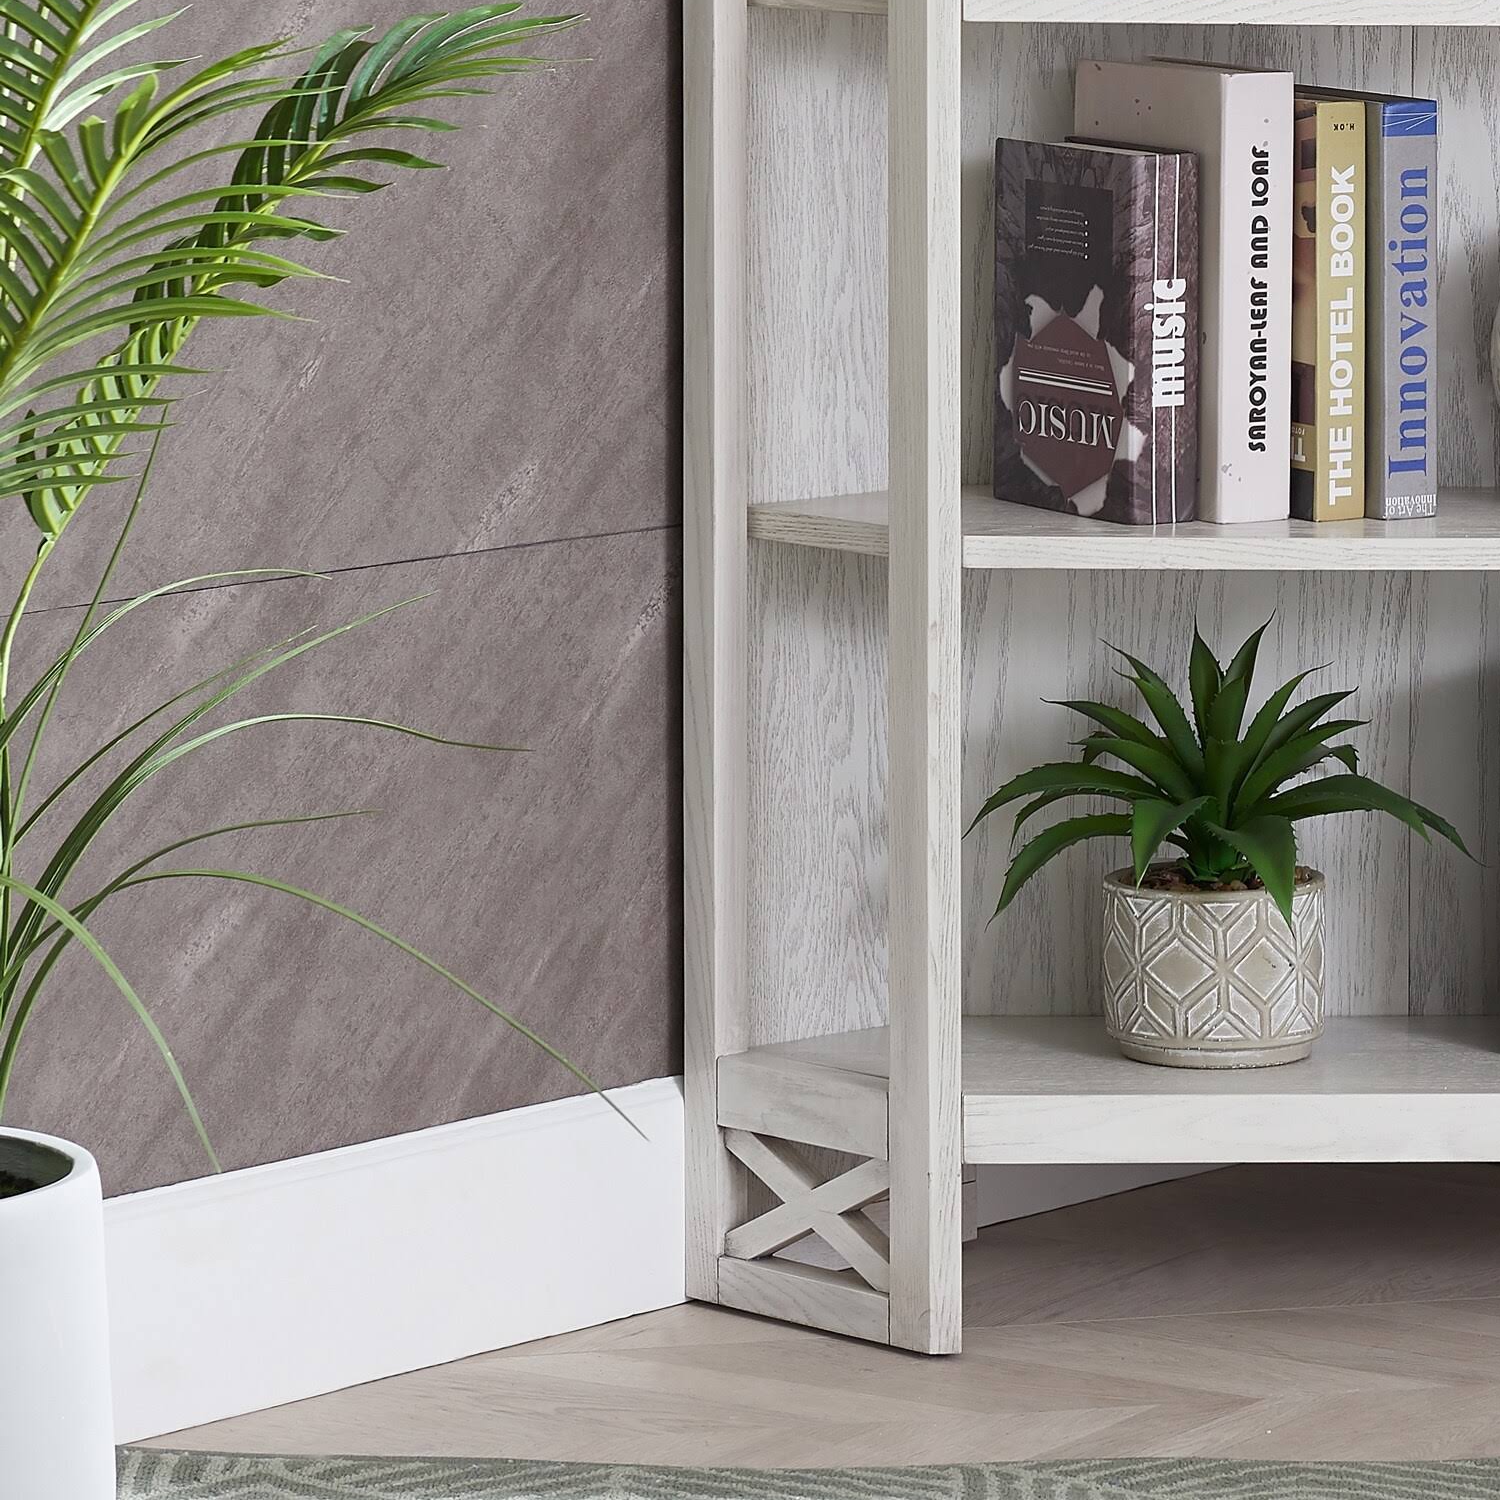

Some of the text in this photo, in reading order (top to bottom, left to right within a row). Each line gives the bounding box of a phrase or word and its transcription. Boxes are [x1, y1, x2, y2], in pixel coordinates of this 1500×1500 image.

[1144, 278, 1187, 408] music
[1248, 146, 1270, 452] SAROYAN-LEAF AND LOAF
[1328, 164, 1355, 506] THE HOTEL BOOK
[1388, 165, 1429, 479] Innovation
[1018, 400, 1116, 450] MUSIC
[1382, 504, 1435, 518] The Art of
[1385, 494, 1436, 506] Innovation
